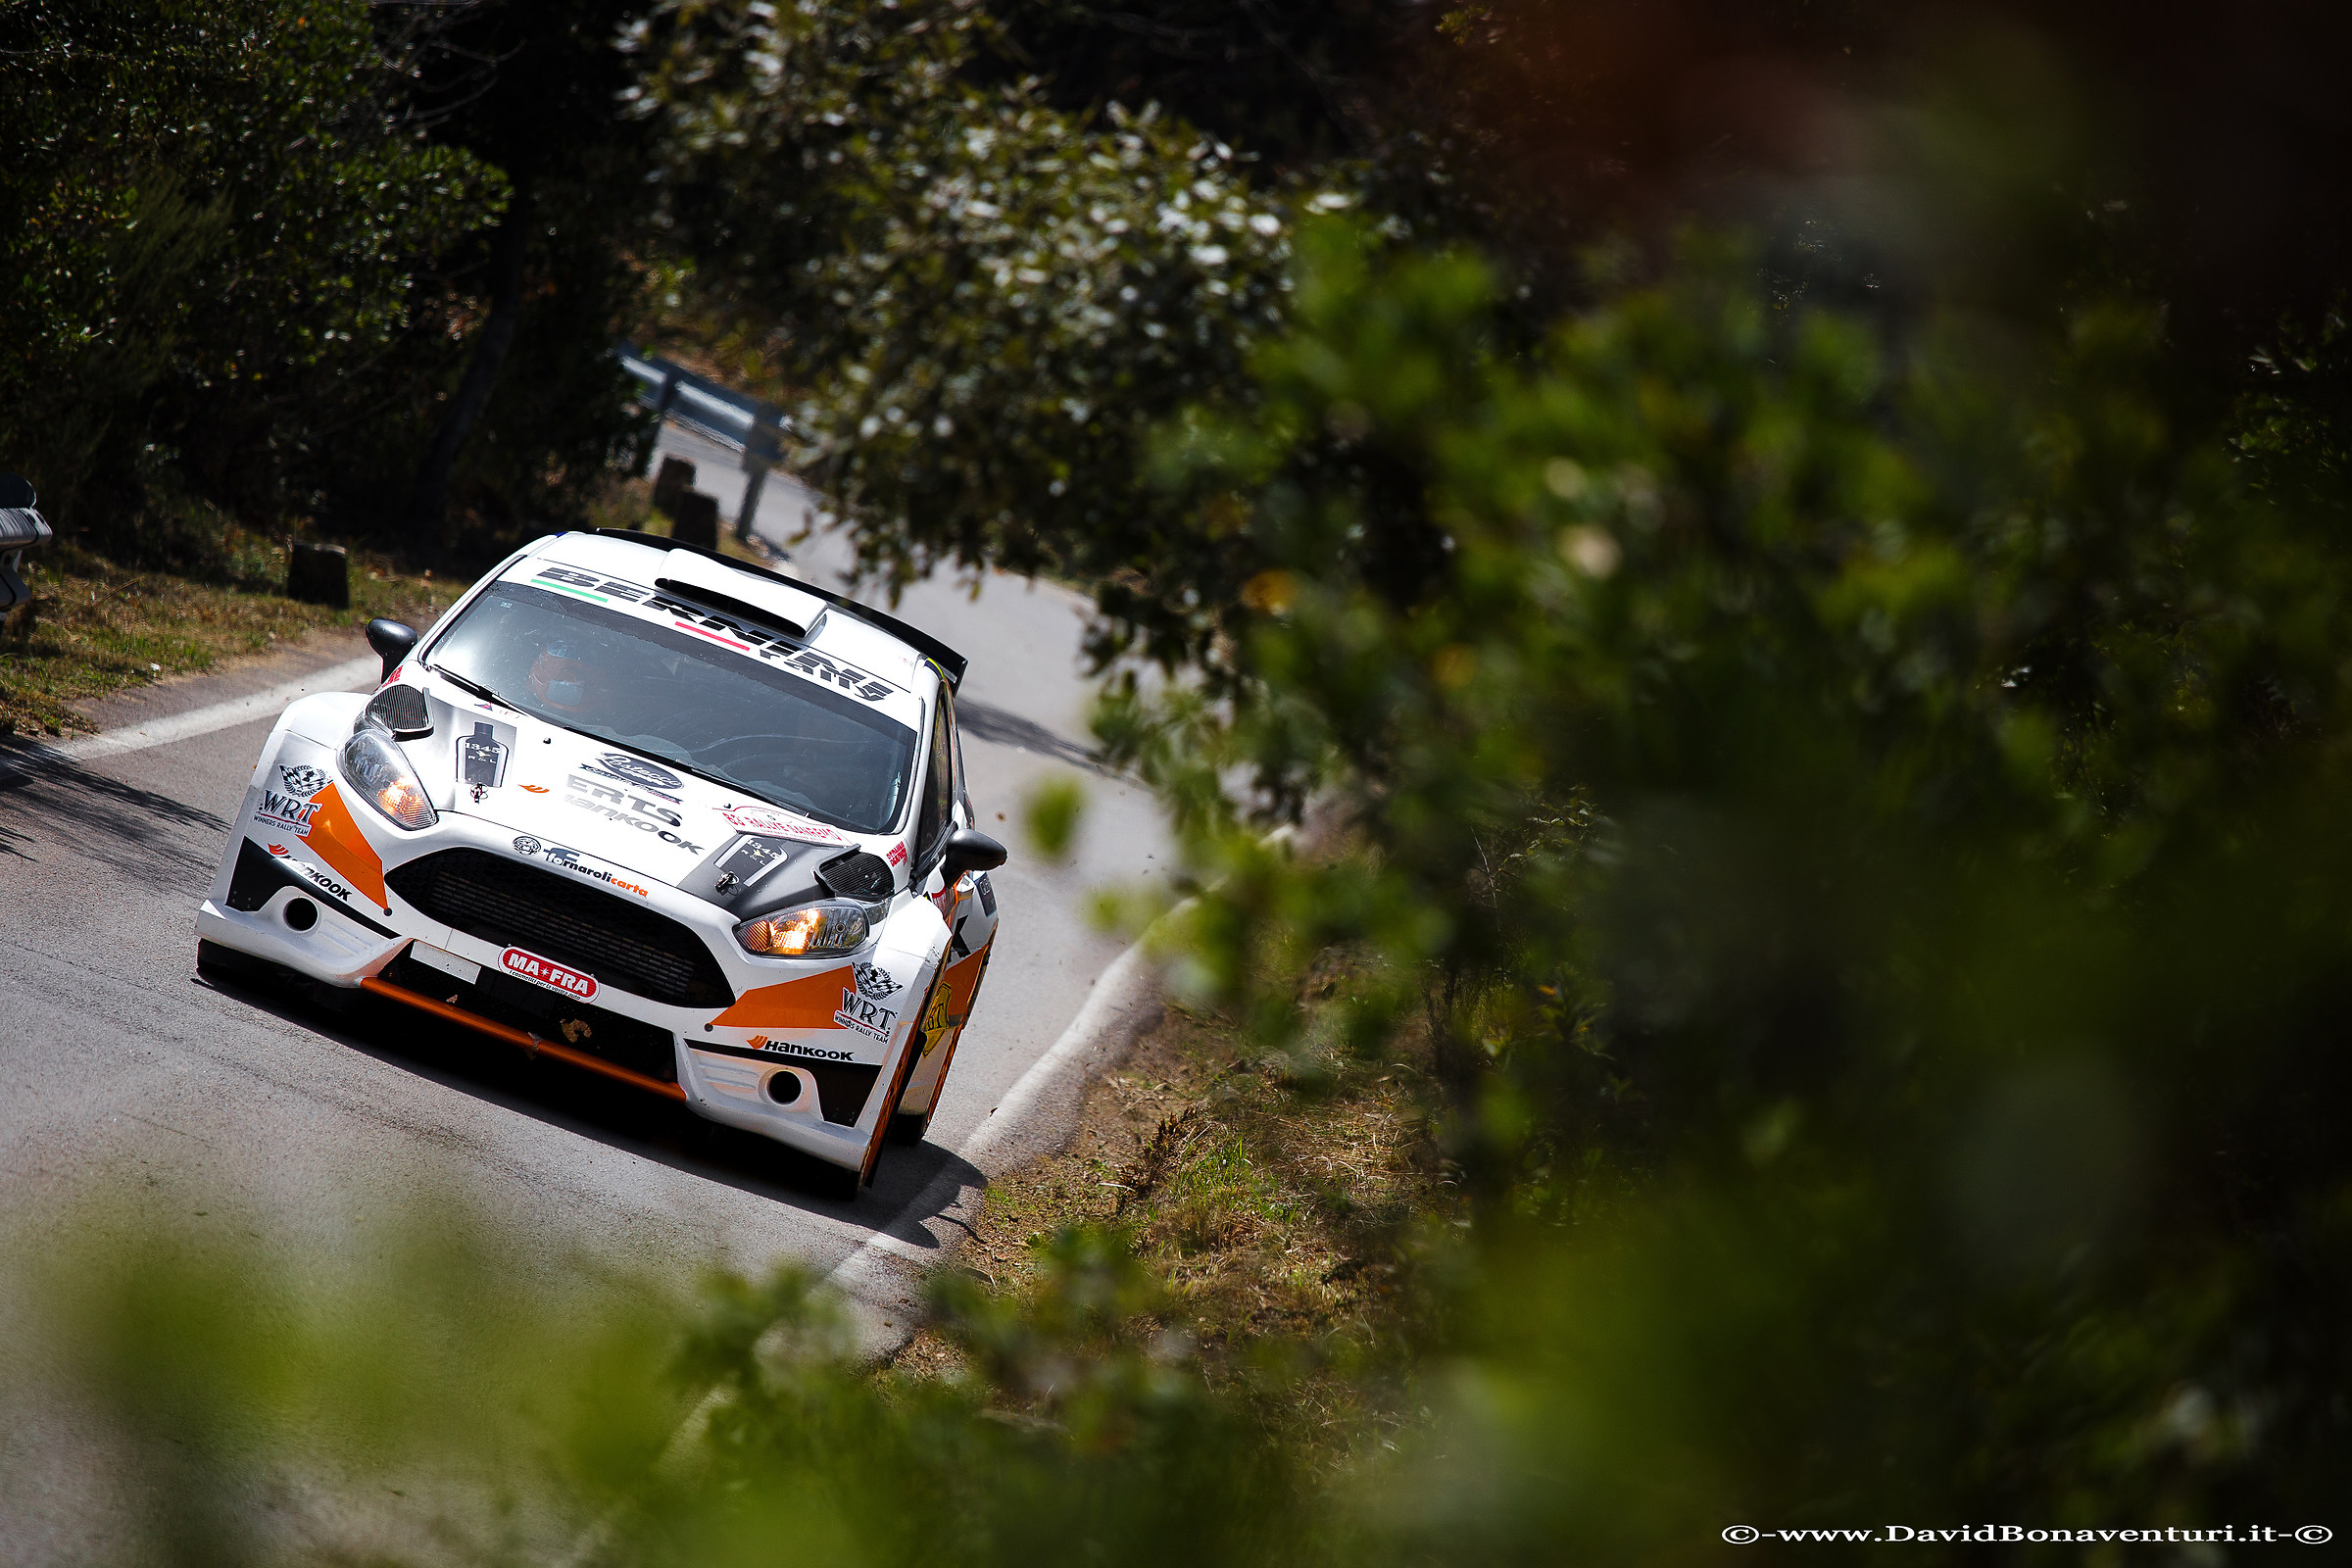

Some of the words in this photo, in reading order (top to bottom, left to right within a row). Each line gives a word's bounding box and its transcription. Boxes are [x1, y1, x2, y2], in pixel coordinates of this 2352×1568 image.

[760, 649, 885, 702] rally
[466, 742, 501, 754] 1345
[264, 790, 322, 824] WRT
[566, 773, 683, 827] ERTS
[254, 815, 276, 827] WINNERS
[276, 823, 294, 832] RALLY
[294, 827, 309, 836] TEAM
[545, 854, 649, 898] fornarolicarta
[843, 988, 899, 1029] WRT
[855, 1025, 872, 1037] RALLY
[872, 1033, 889, 1044] TEAM
